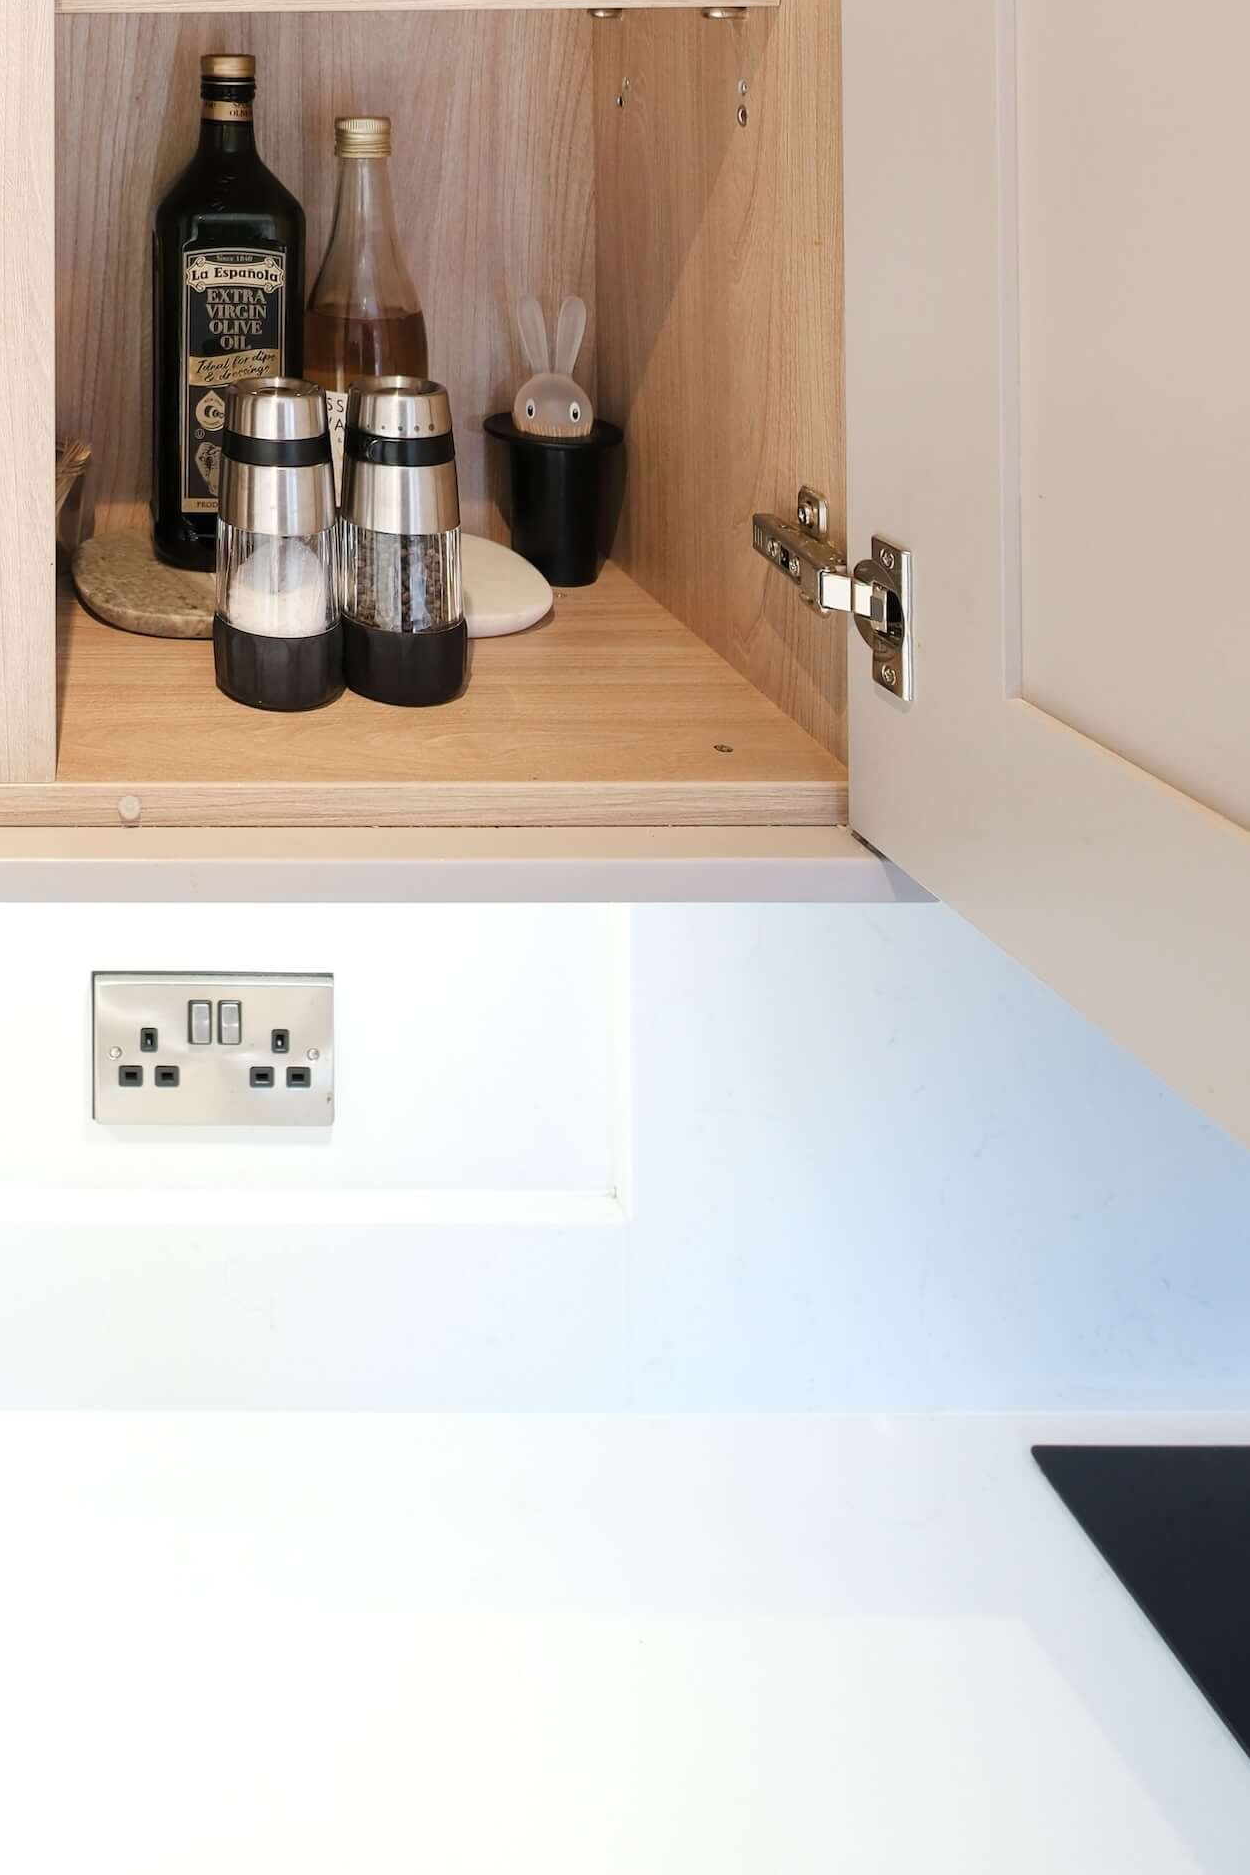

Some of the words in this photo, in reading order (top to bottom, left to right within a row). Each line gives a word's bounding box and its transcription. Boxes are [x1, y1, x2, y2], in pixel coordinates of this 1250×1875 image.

[192, 270, 208, 281] La
[214, 267, 278, 282] Española
[206, 288, 267, 304] EXTRA
[206, 304, 267, 319] VIRGIN
[209, 319, 263, 335] OLIVE
[220, 335, 252, 350] OIL
[196, 357, 230, 374] Ideal
[230, 356, 249, 369] for
[204, 371, 215, 383] &
[218, 365, 270, 381] dressings
[196, 501, 218, 509] PROD
